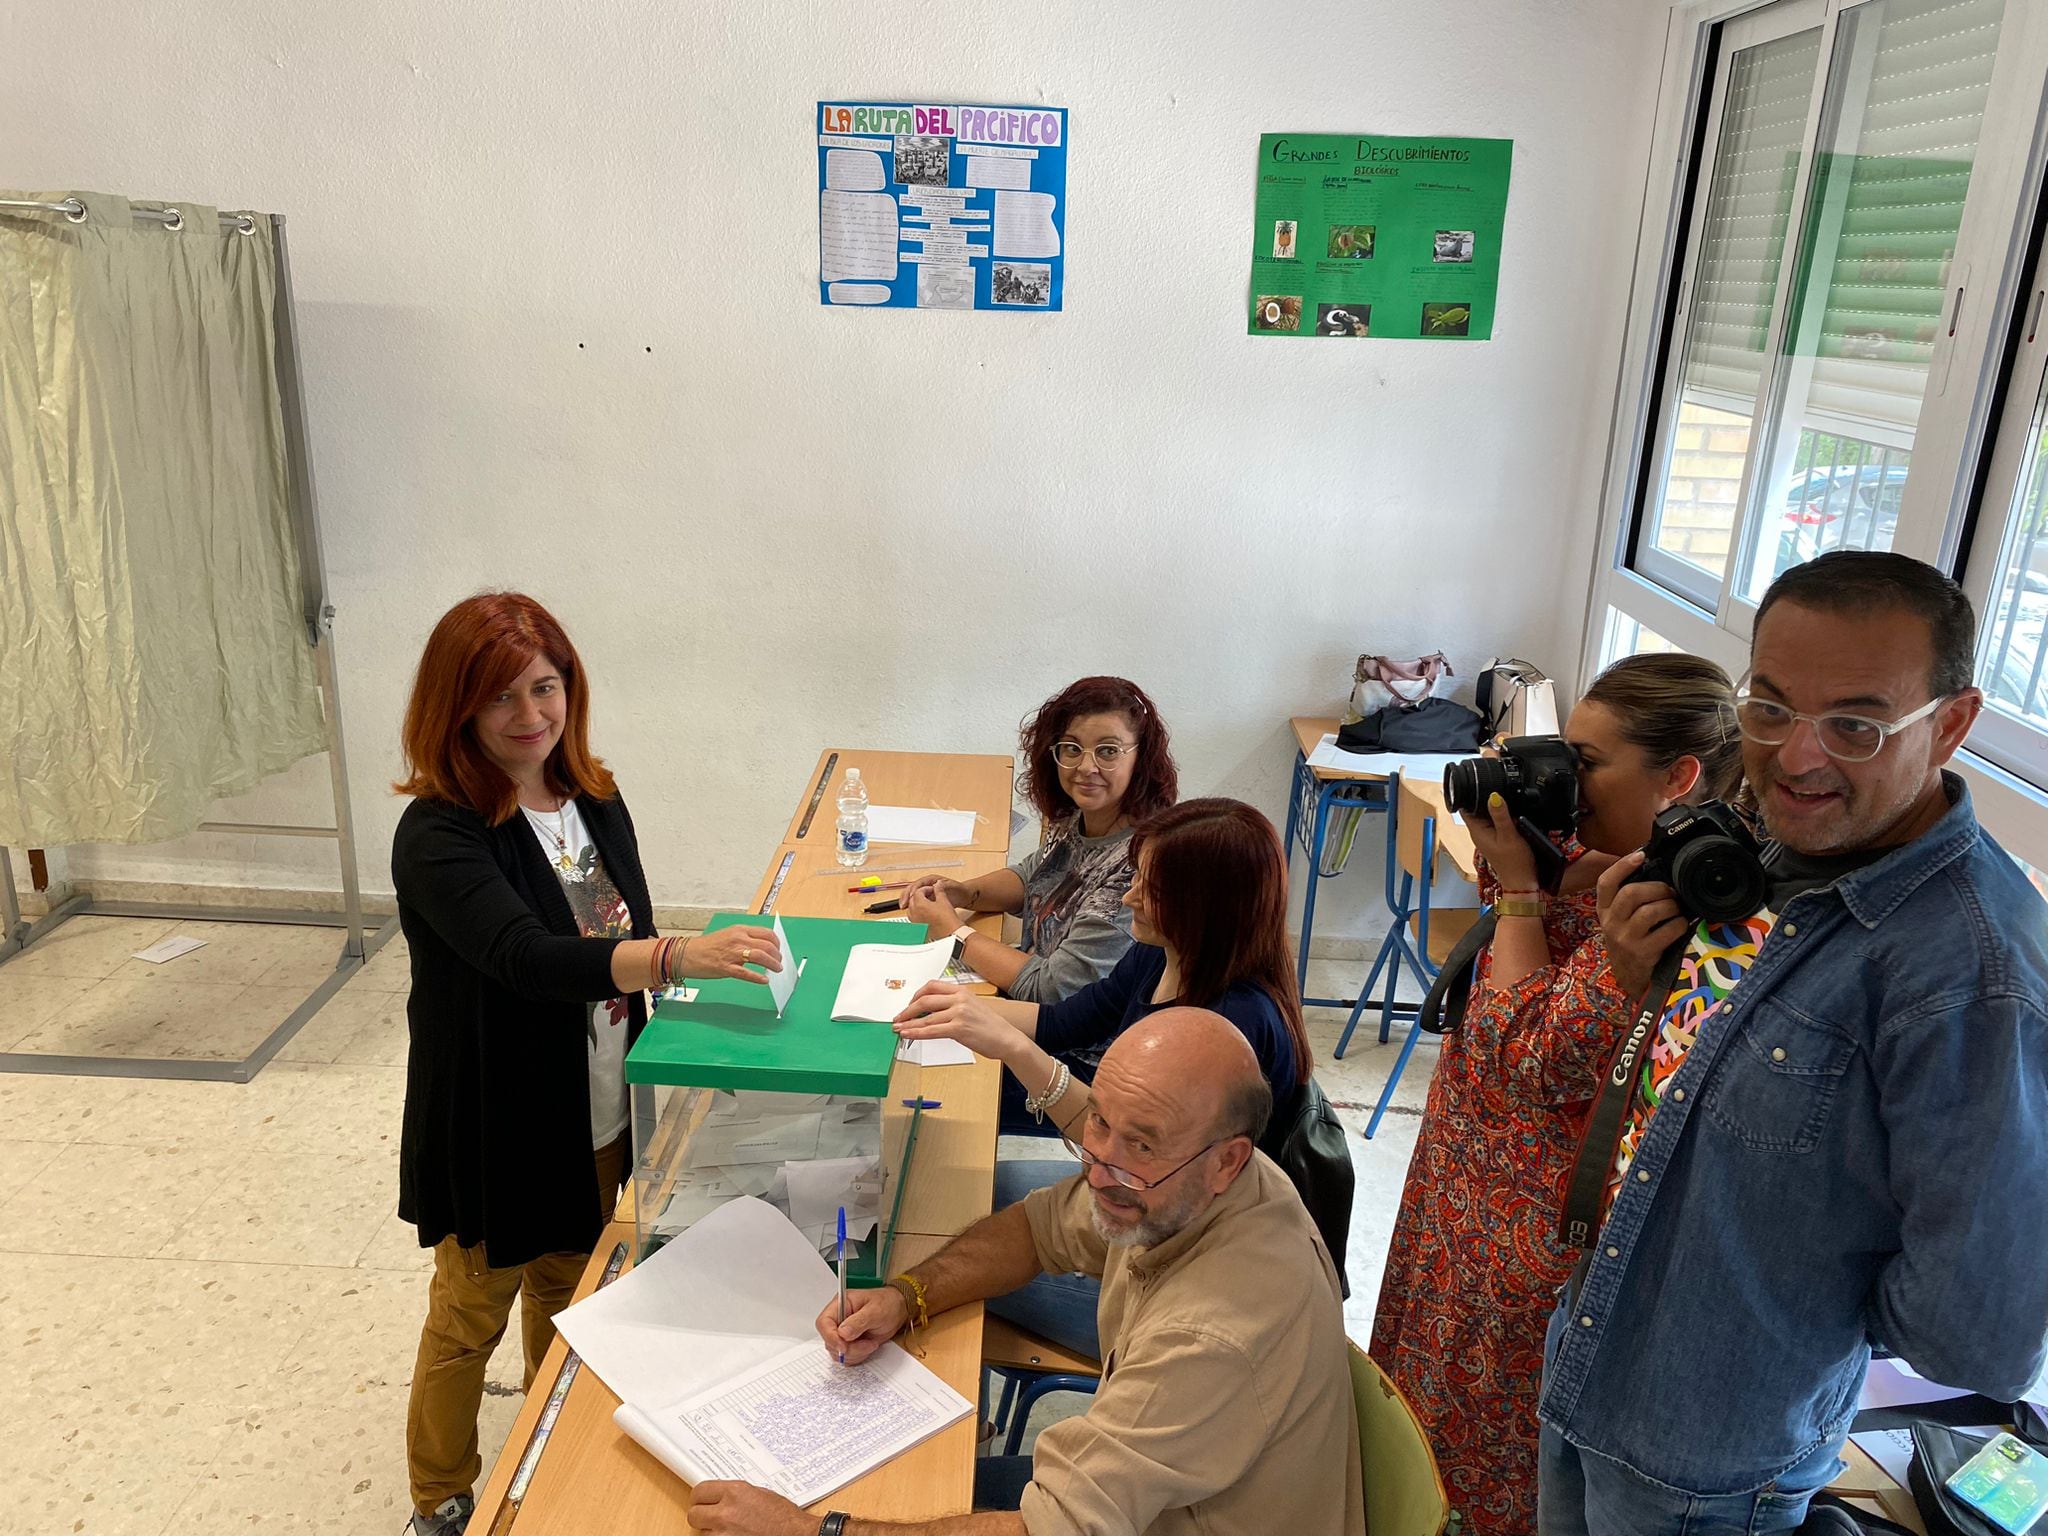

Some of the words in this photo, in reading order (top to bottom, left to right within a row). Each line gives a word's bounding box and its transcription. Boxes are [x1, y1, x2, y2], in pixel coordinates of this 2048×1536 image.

[825, 107, 852, 132] LA
[854, 108, 912, 134] RUTA
[915, 108, 955, 135] DEL
[1272, 139, 1338, 162] GRANDES
[1666, 816, 1695, 836] Canon
[1612, 1010, 1654, 1087] Canon
